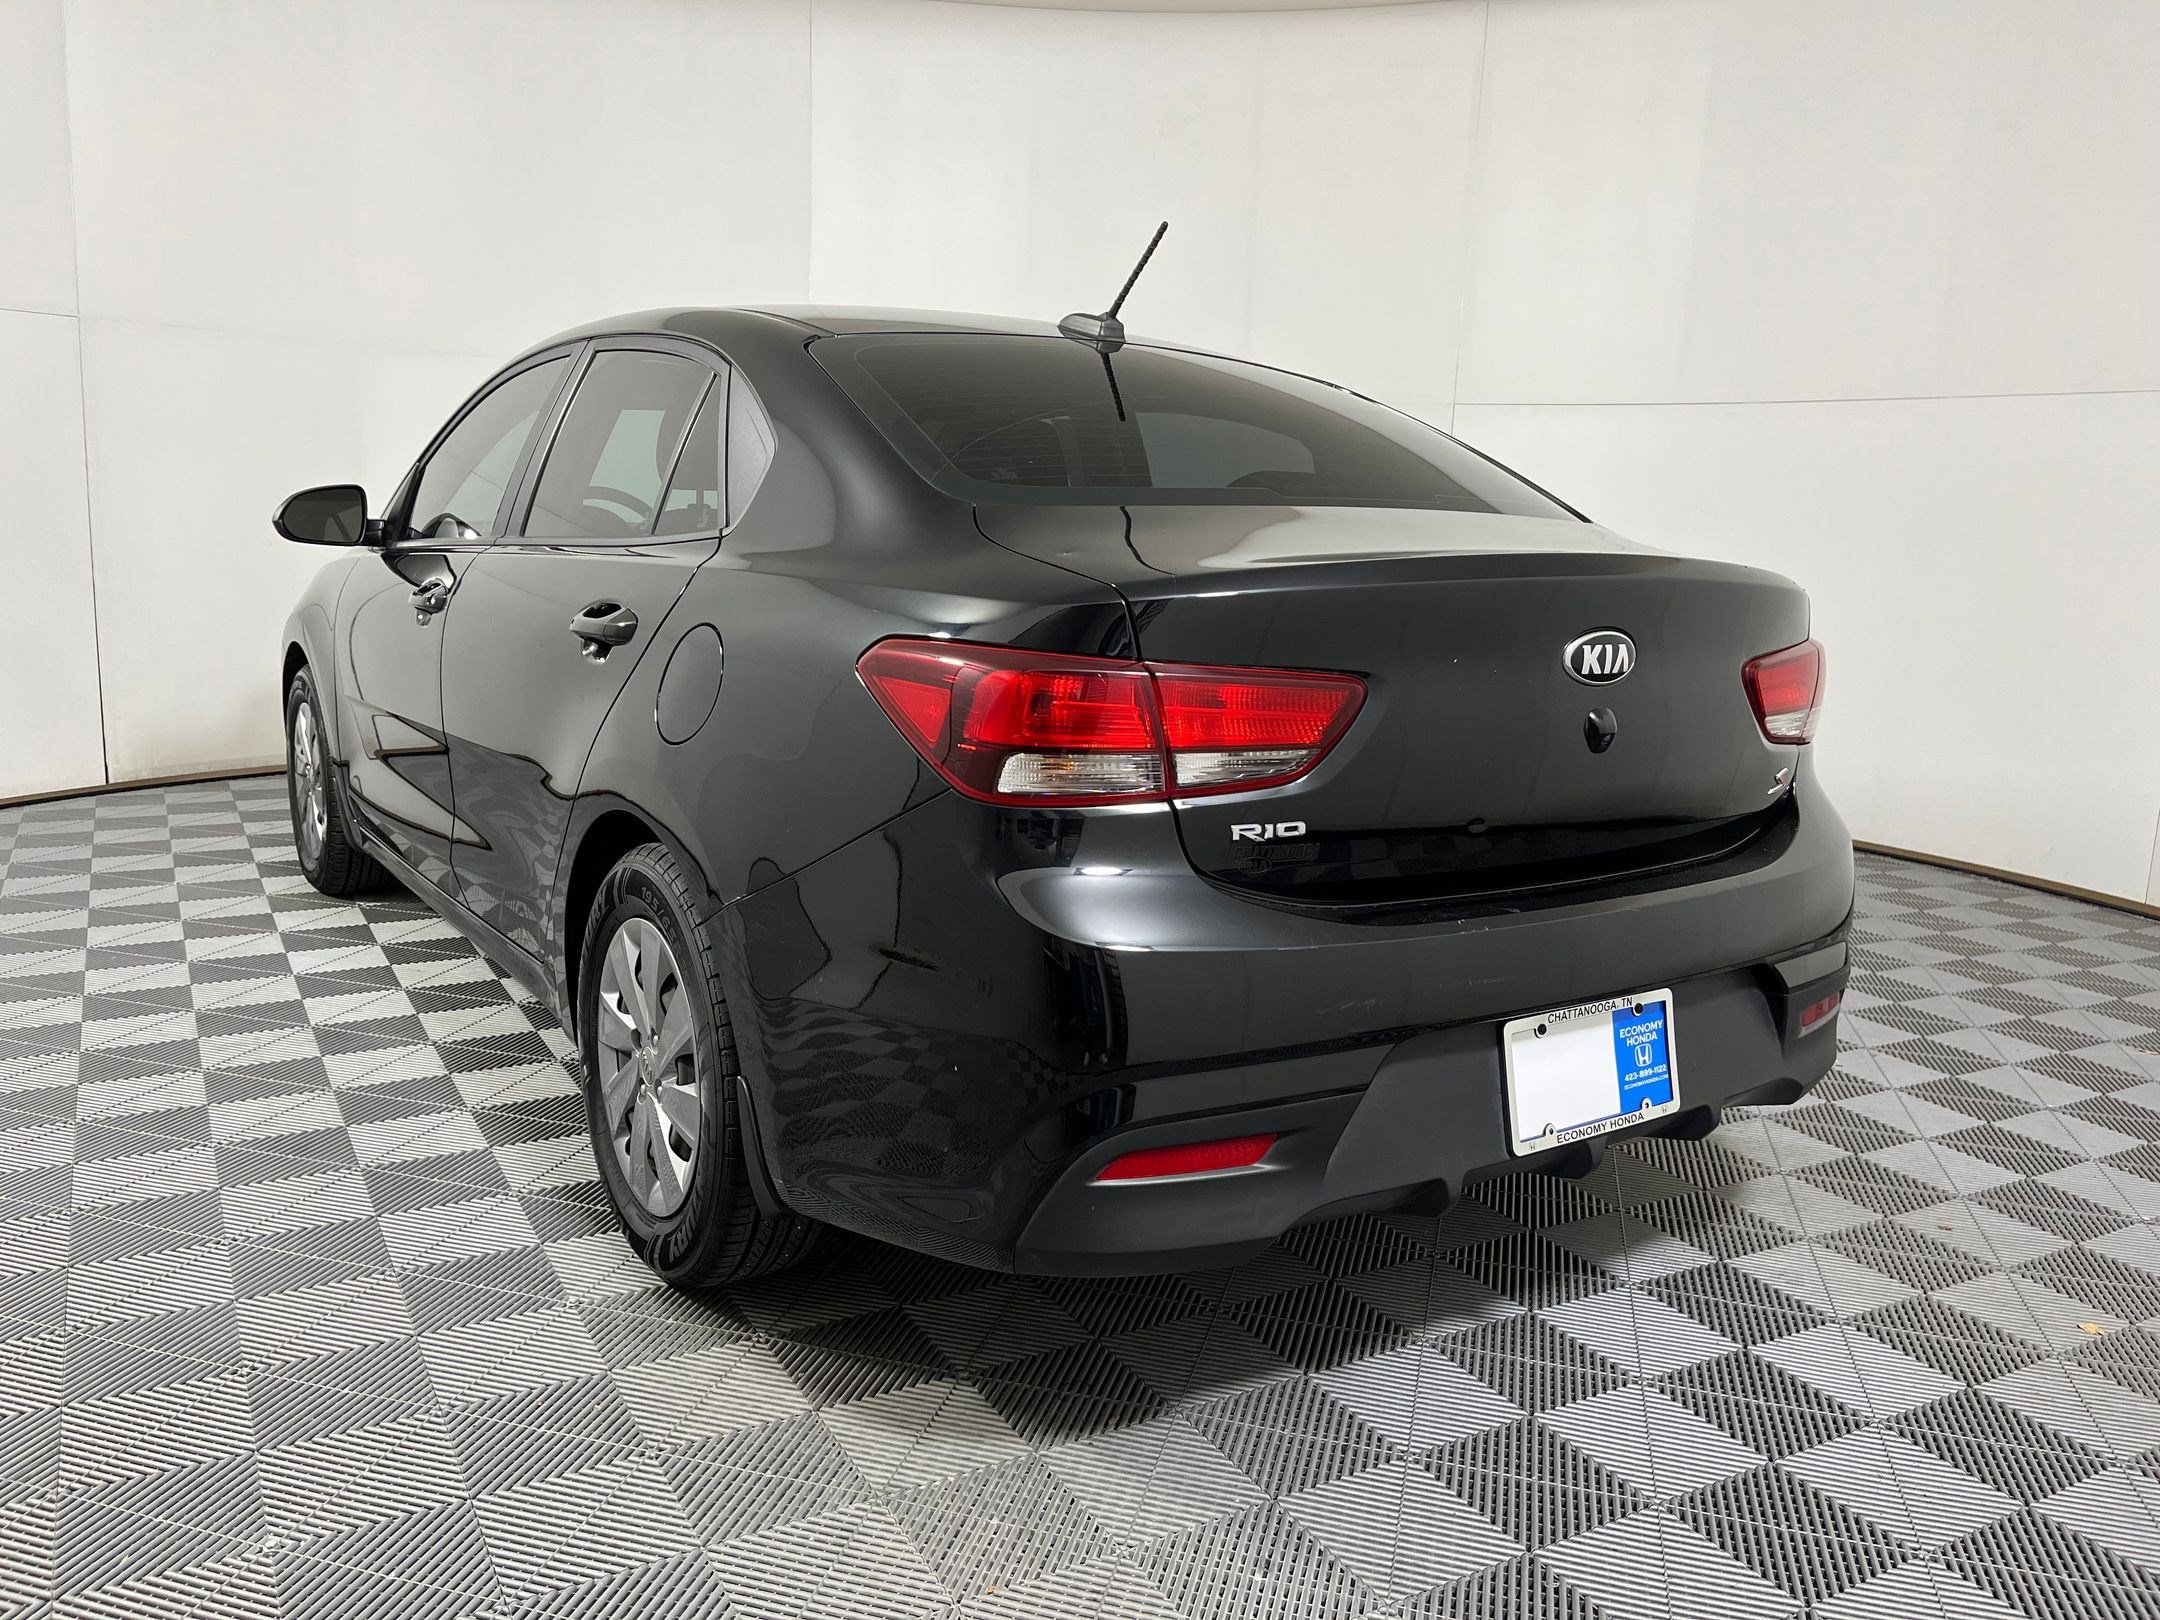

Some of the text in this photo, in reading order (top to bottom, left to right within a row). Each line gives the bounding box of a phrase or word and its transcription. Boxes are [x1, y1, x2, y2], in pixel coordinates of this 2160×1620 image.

[1581, 643, 1629, 675] KIA
[1230, 820, 1307, 842] RIO
[1621, 997, 1633, 1007] TN
[1619, 1019, 1664, 1039] ECONOMY
[1626, 1031, 1658, 1047] HONDA
[1624, 1064, 1668, 1081] 423-899-1122
[1556, 1112, 1645, 1144] ECONOMY HONDA
